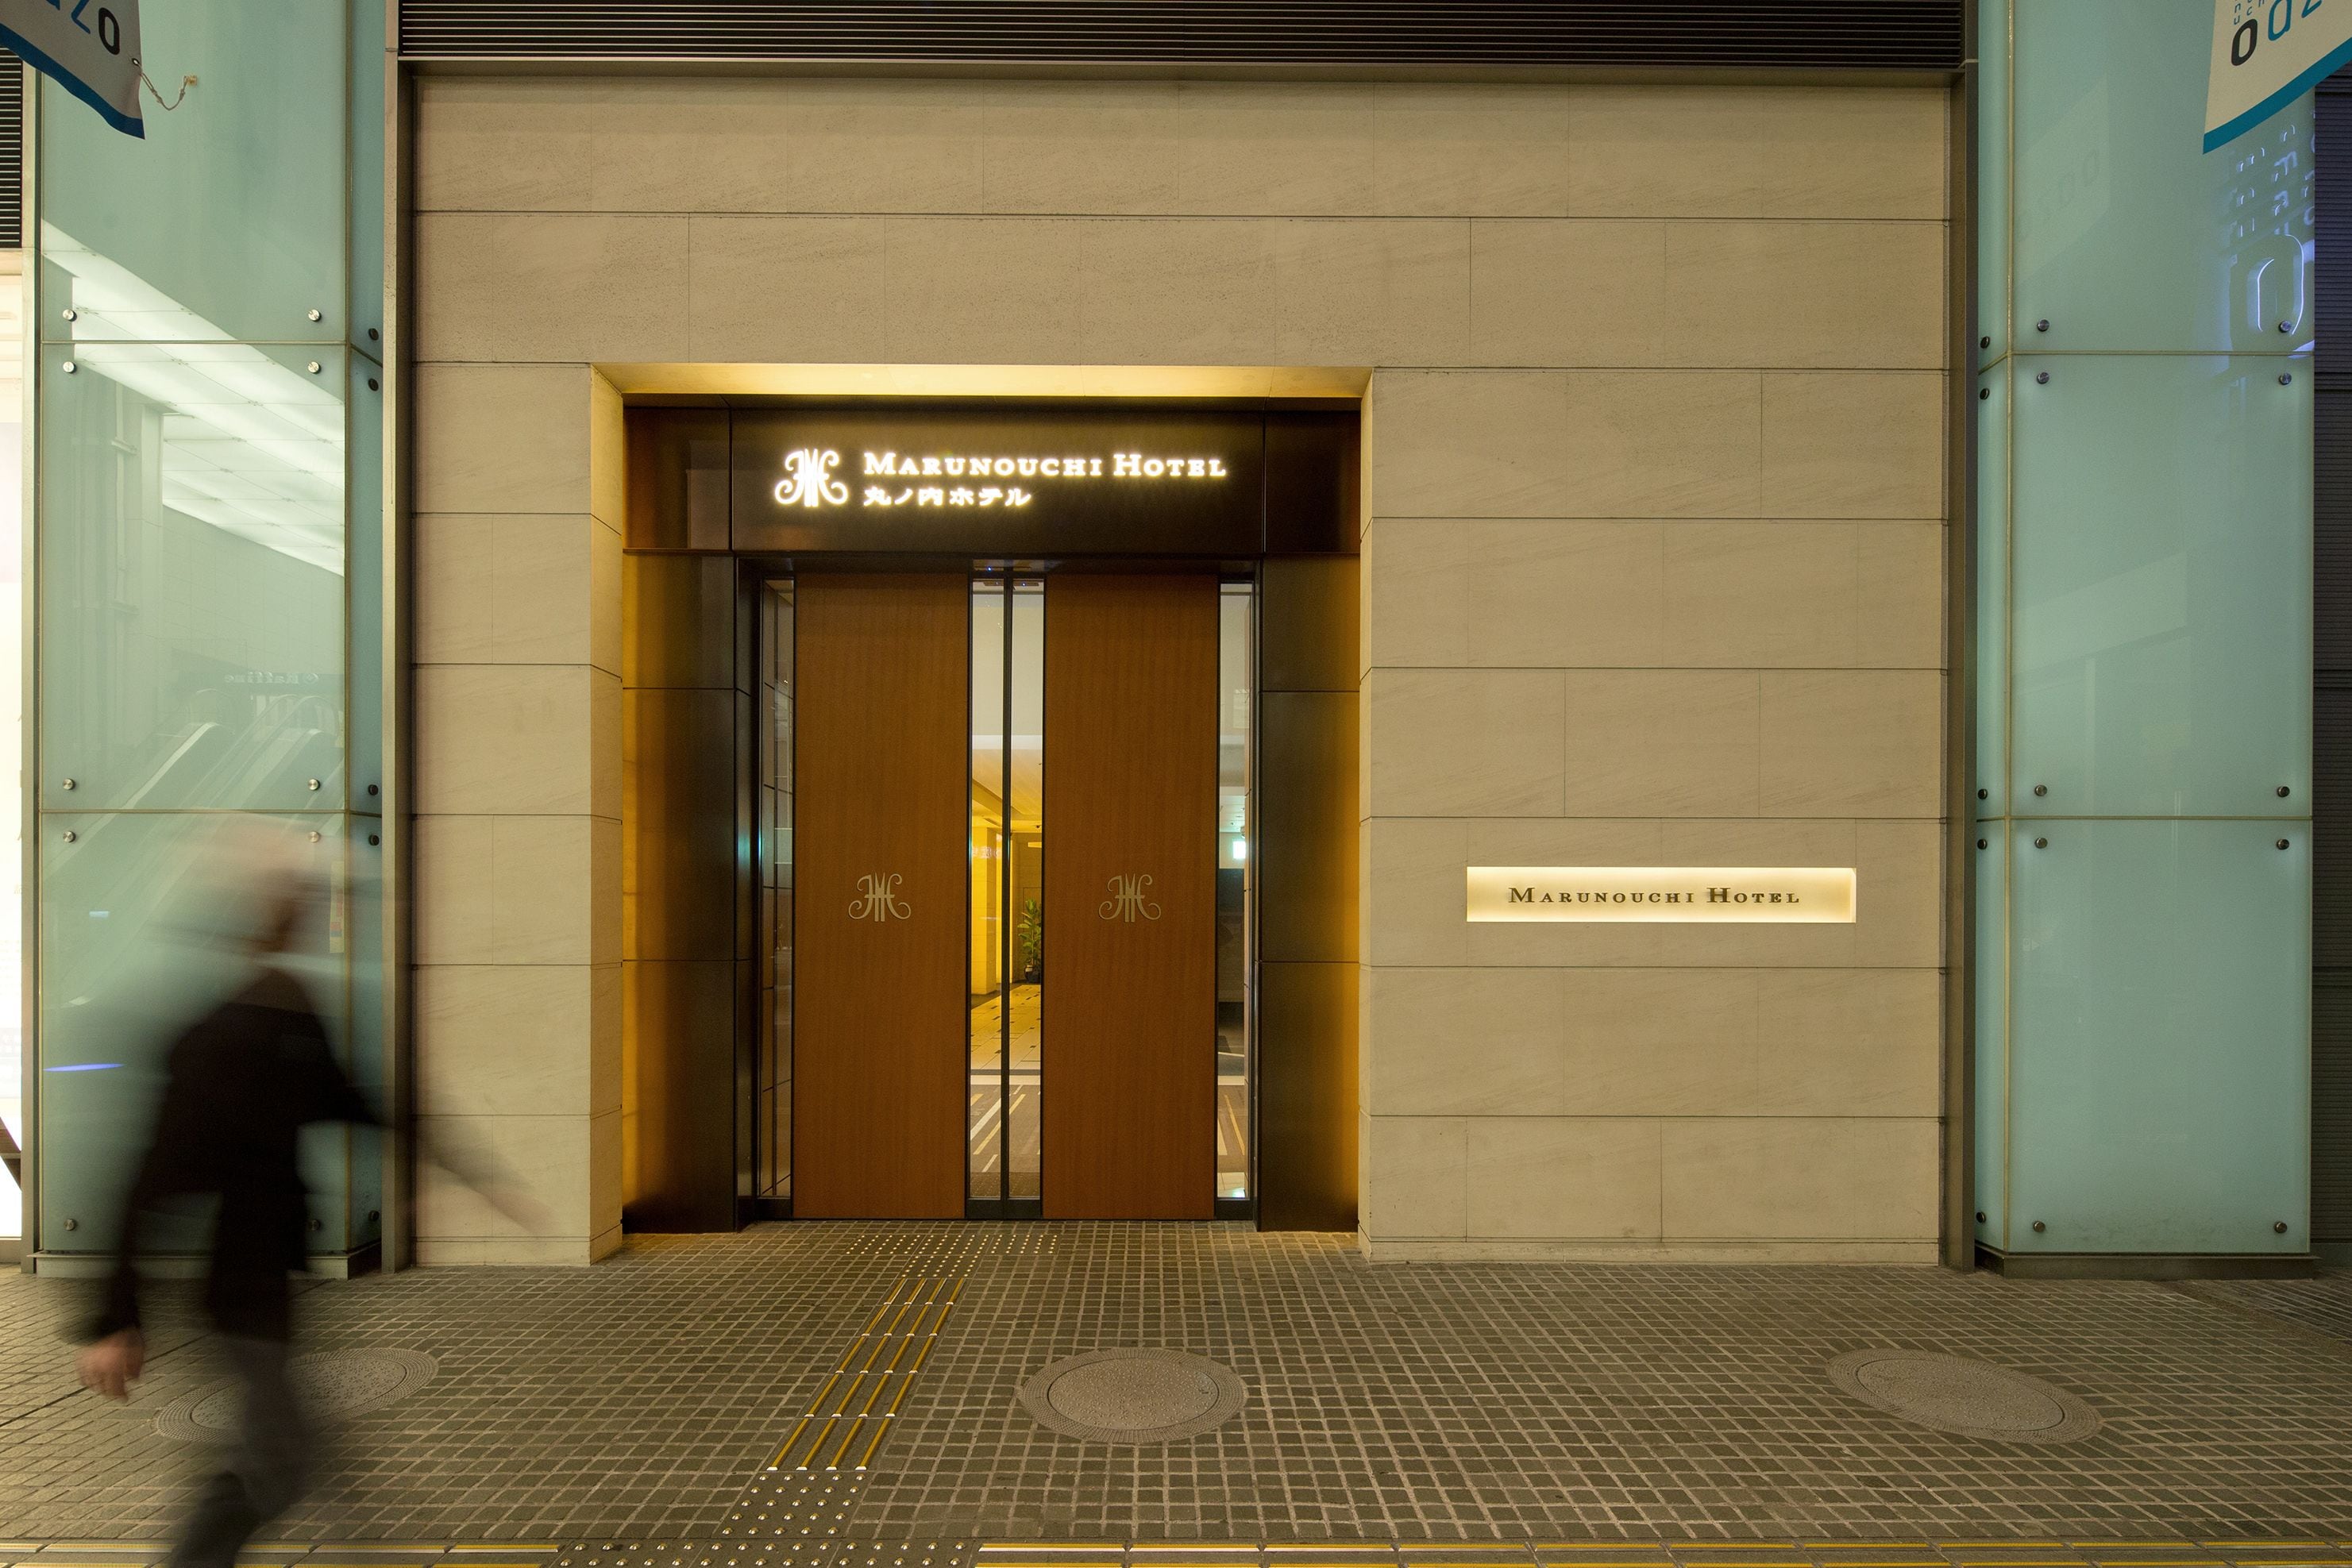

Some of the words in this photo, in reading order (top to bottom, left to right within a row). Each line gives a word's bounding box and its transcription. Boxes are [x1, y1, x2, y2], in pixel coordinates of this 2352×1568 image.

[863, 452, 1103, 476] MARUNOUCHI
[1112, 453, 1227, 477] HOTEL
[863, 487, 1032, 507] 丸ノ内ホテル
[1508, 887, 1695, 903] MARUNOUCHI
[1706, 887, 1801, 903] HOTEL
